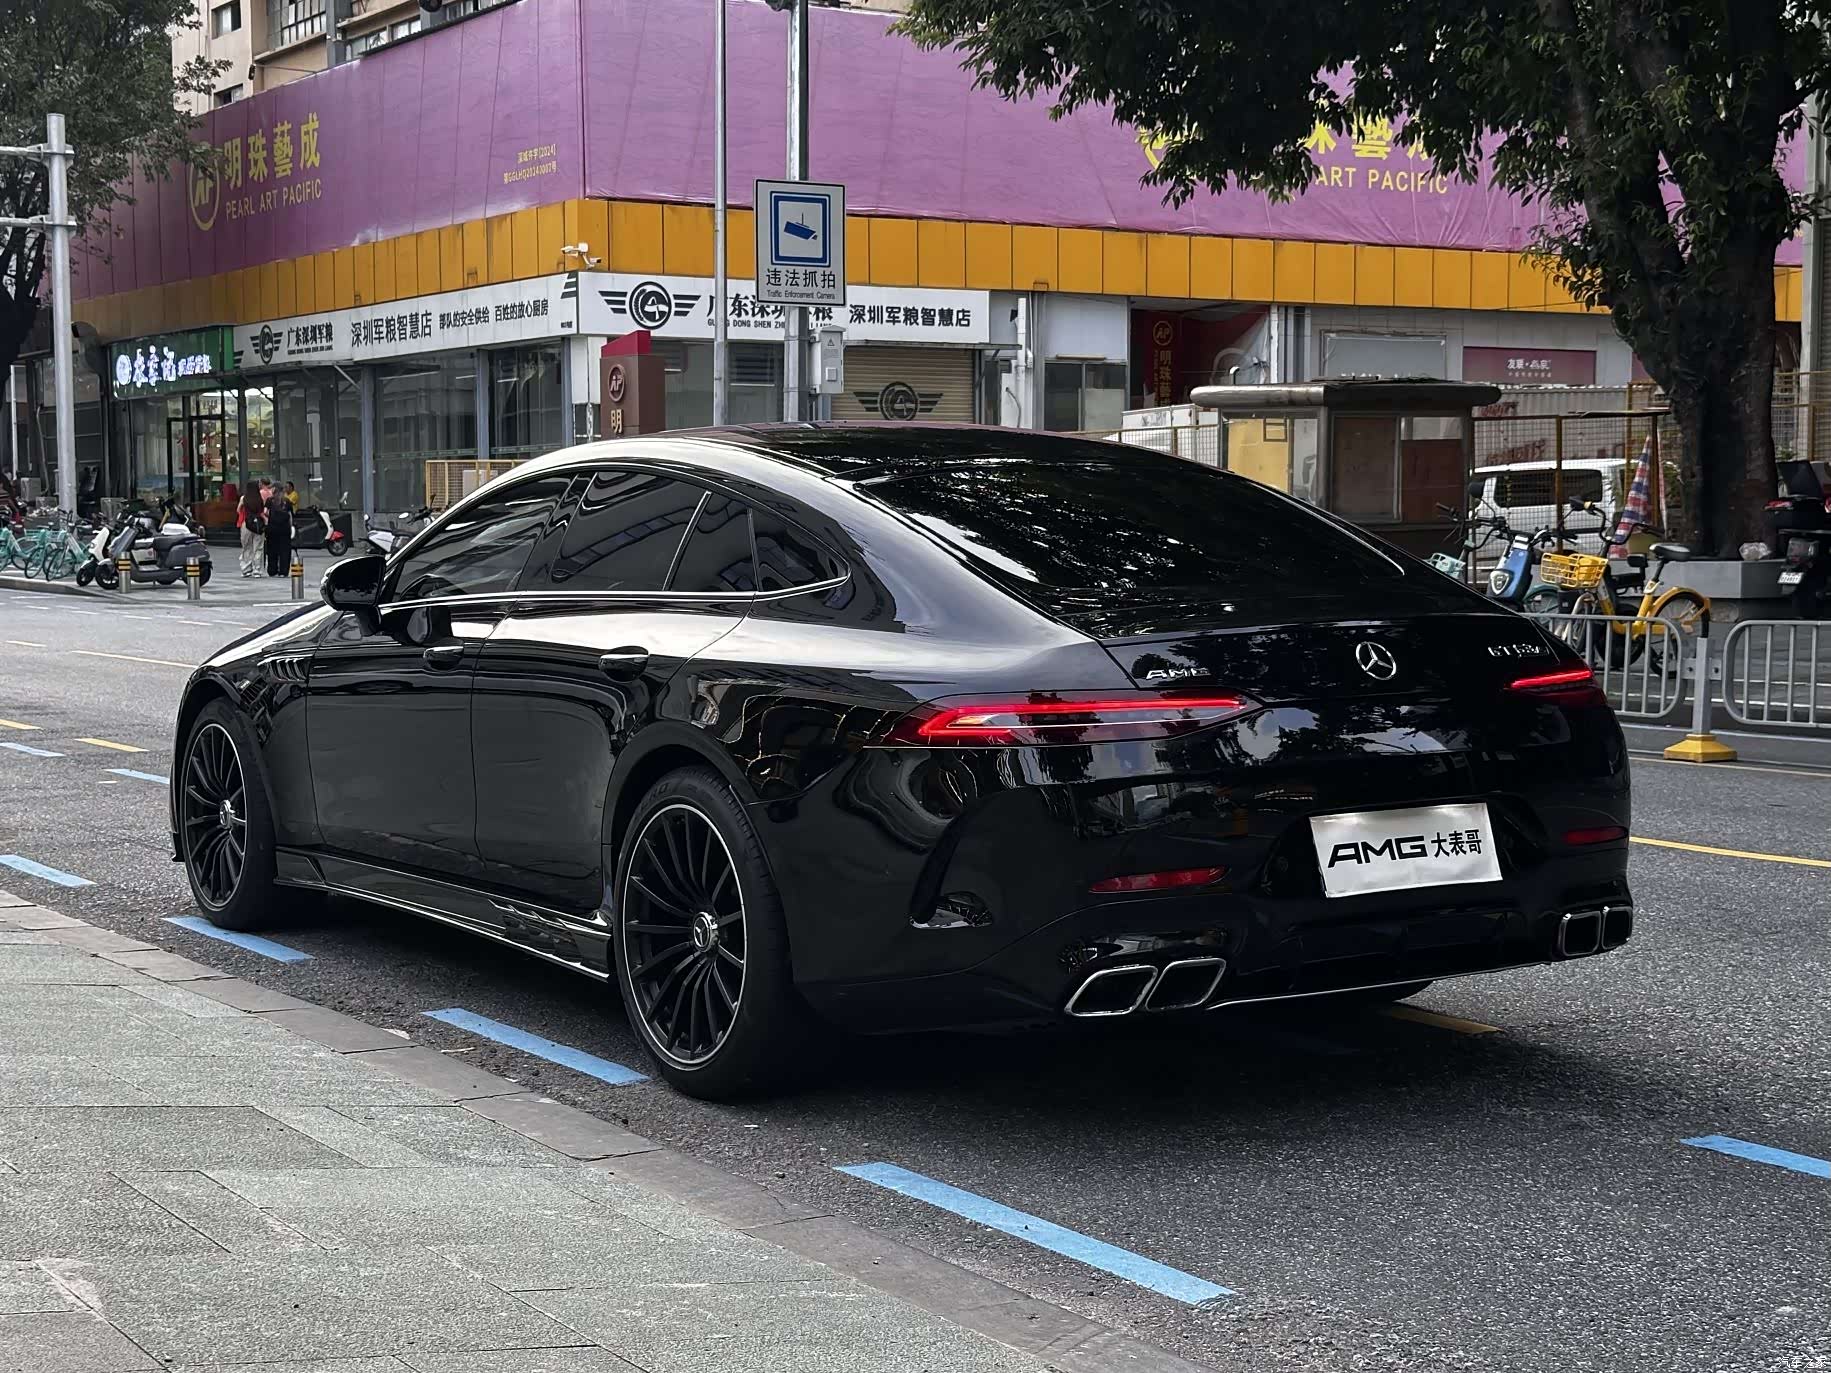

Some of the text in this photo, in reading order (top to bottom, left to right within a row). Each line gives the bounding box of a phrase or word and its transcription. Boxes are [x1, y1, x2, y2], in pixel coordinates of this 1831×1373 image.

[1315, 165, 1449, 195] ART PACIFIC
[225, 178, 322, 222] PEARL ART PACIFIC
[766, 267, 836, 289] 违法抓拍
[767, 289, 836, 300] Traffic Enforcement Camera
[351, 298, 549, 348] 深圳军粮智慧店 部队的安全供给 百姓的放心厨房
[732, 319, 751, 328] DONG
[753, 319, 772, 329] SHEN
[849, 303, 972, 328] 深圳军粮智慧店
[287, 321, 334, 348] 广东深圳军粮
[610, 408, 623, 433] 明
[1327, 829, 1482, 868] AMG 大表哥
